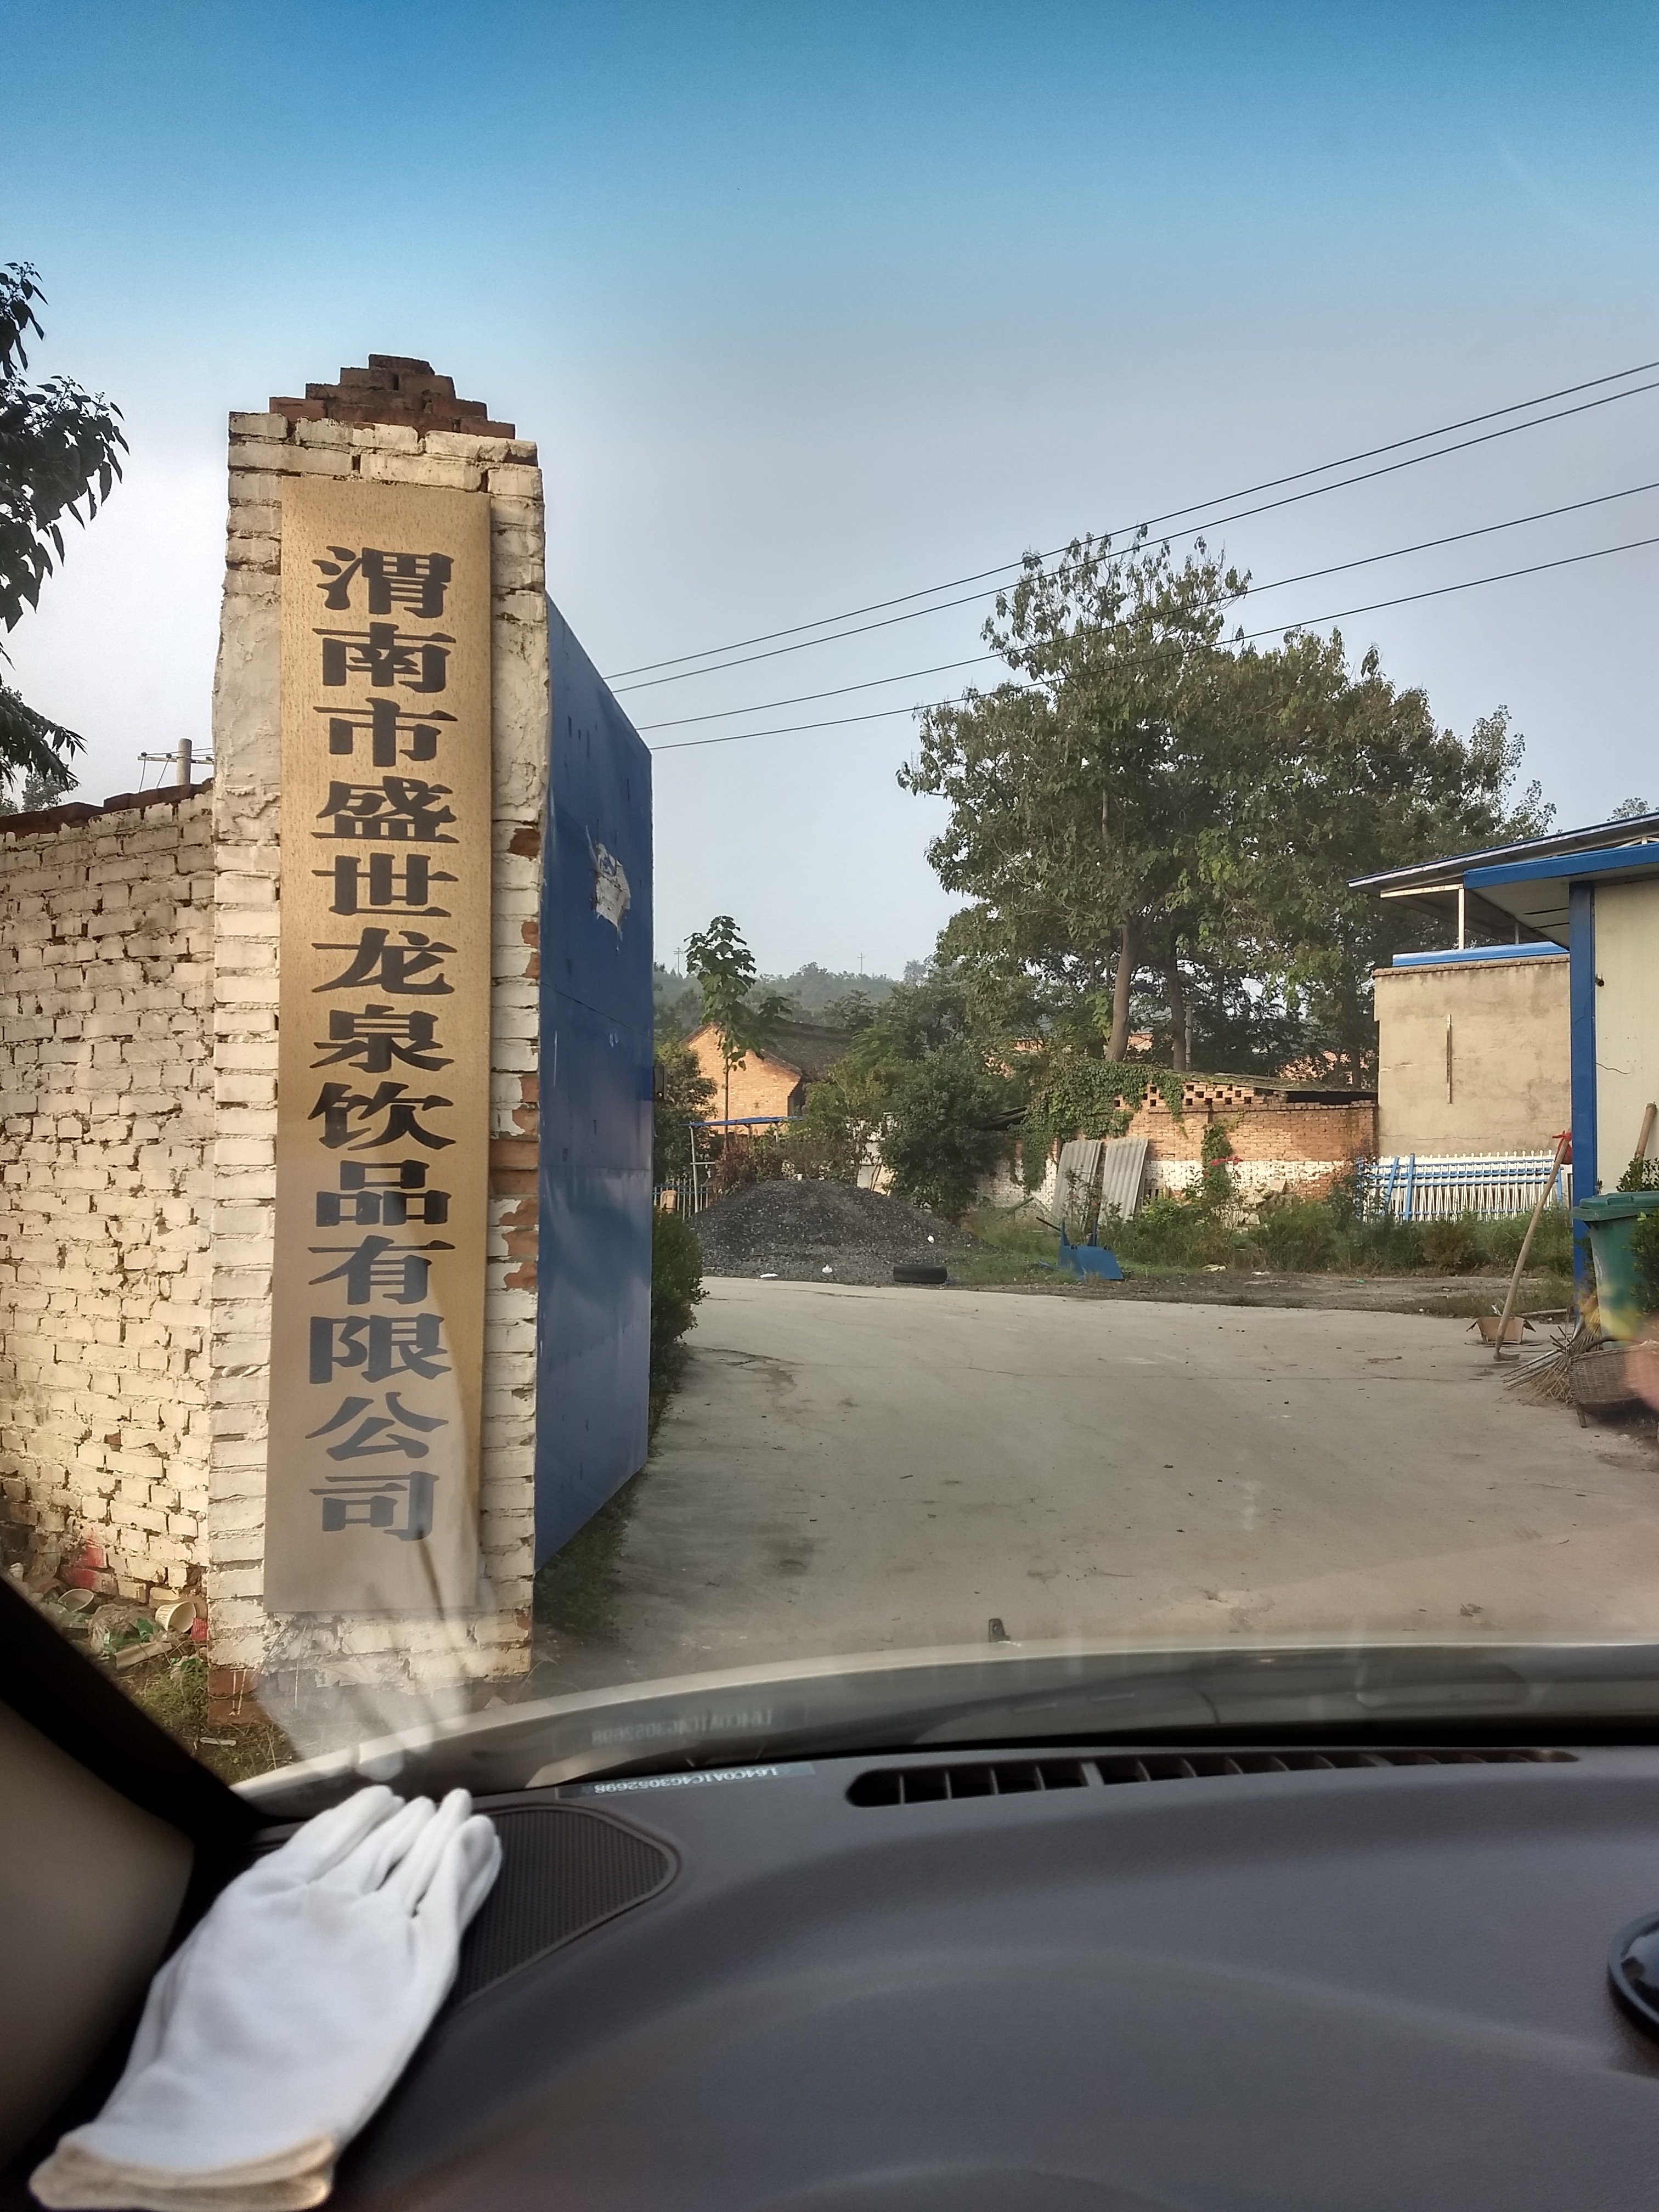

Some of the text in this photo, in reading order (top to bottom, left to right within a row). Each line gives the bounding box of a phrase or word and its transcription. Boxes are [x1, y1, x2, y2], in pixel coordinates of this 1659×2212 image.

[306, 545, 459, 1541] 渭南市盛世龙泉饮品有限公司
